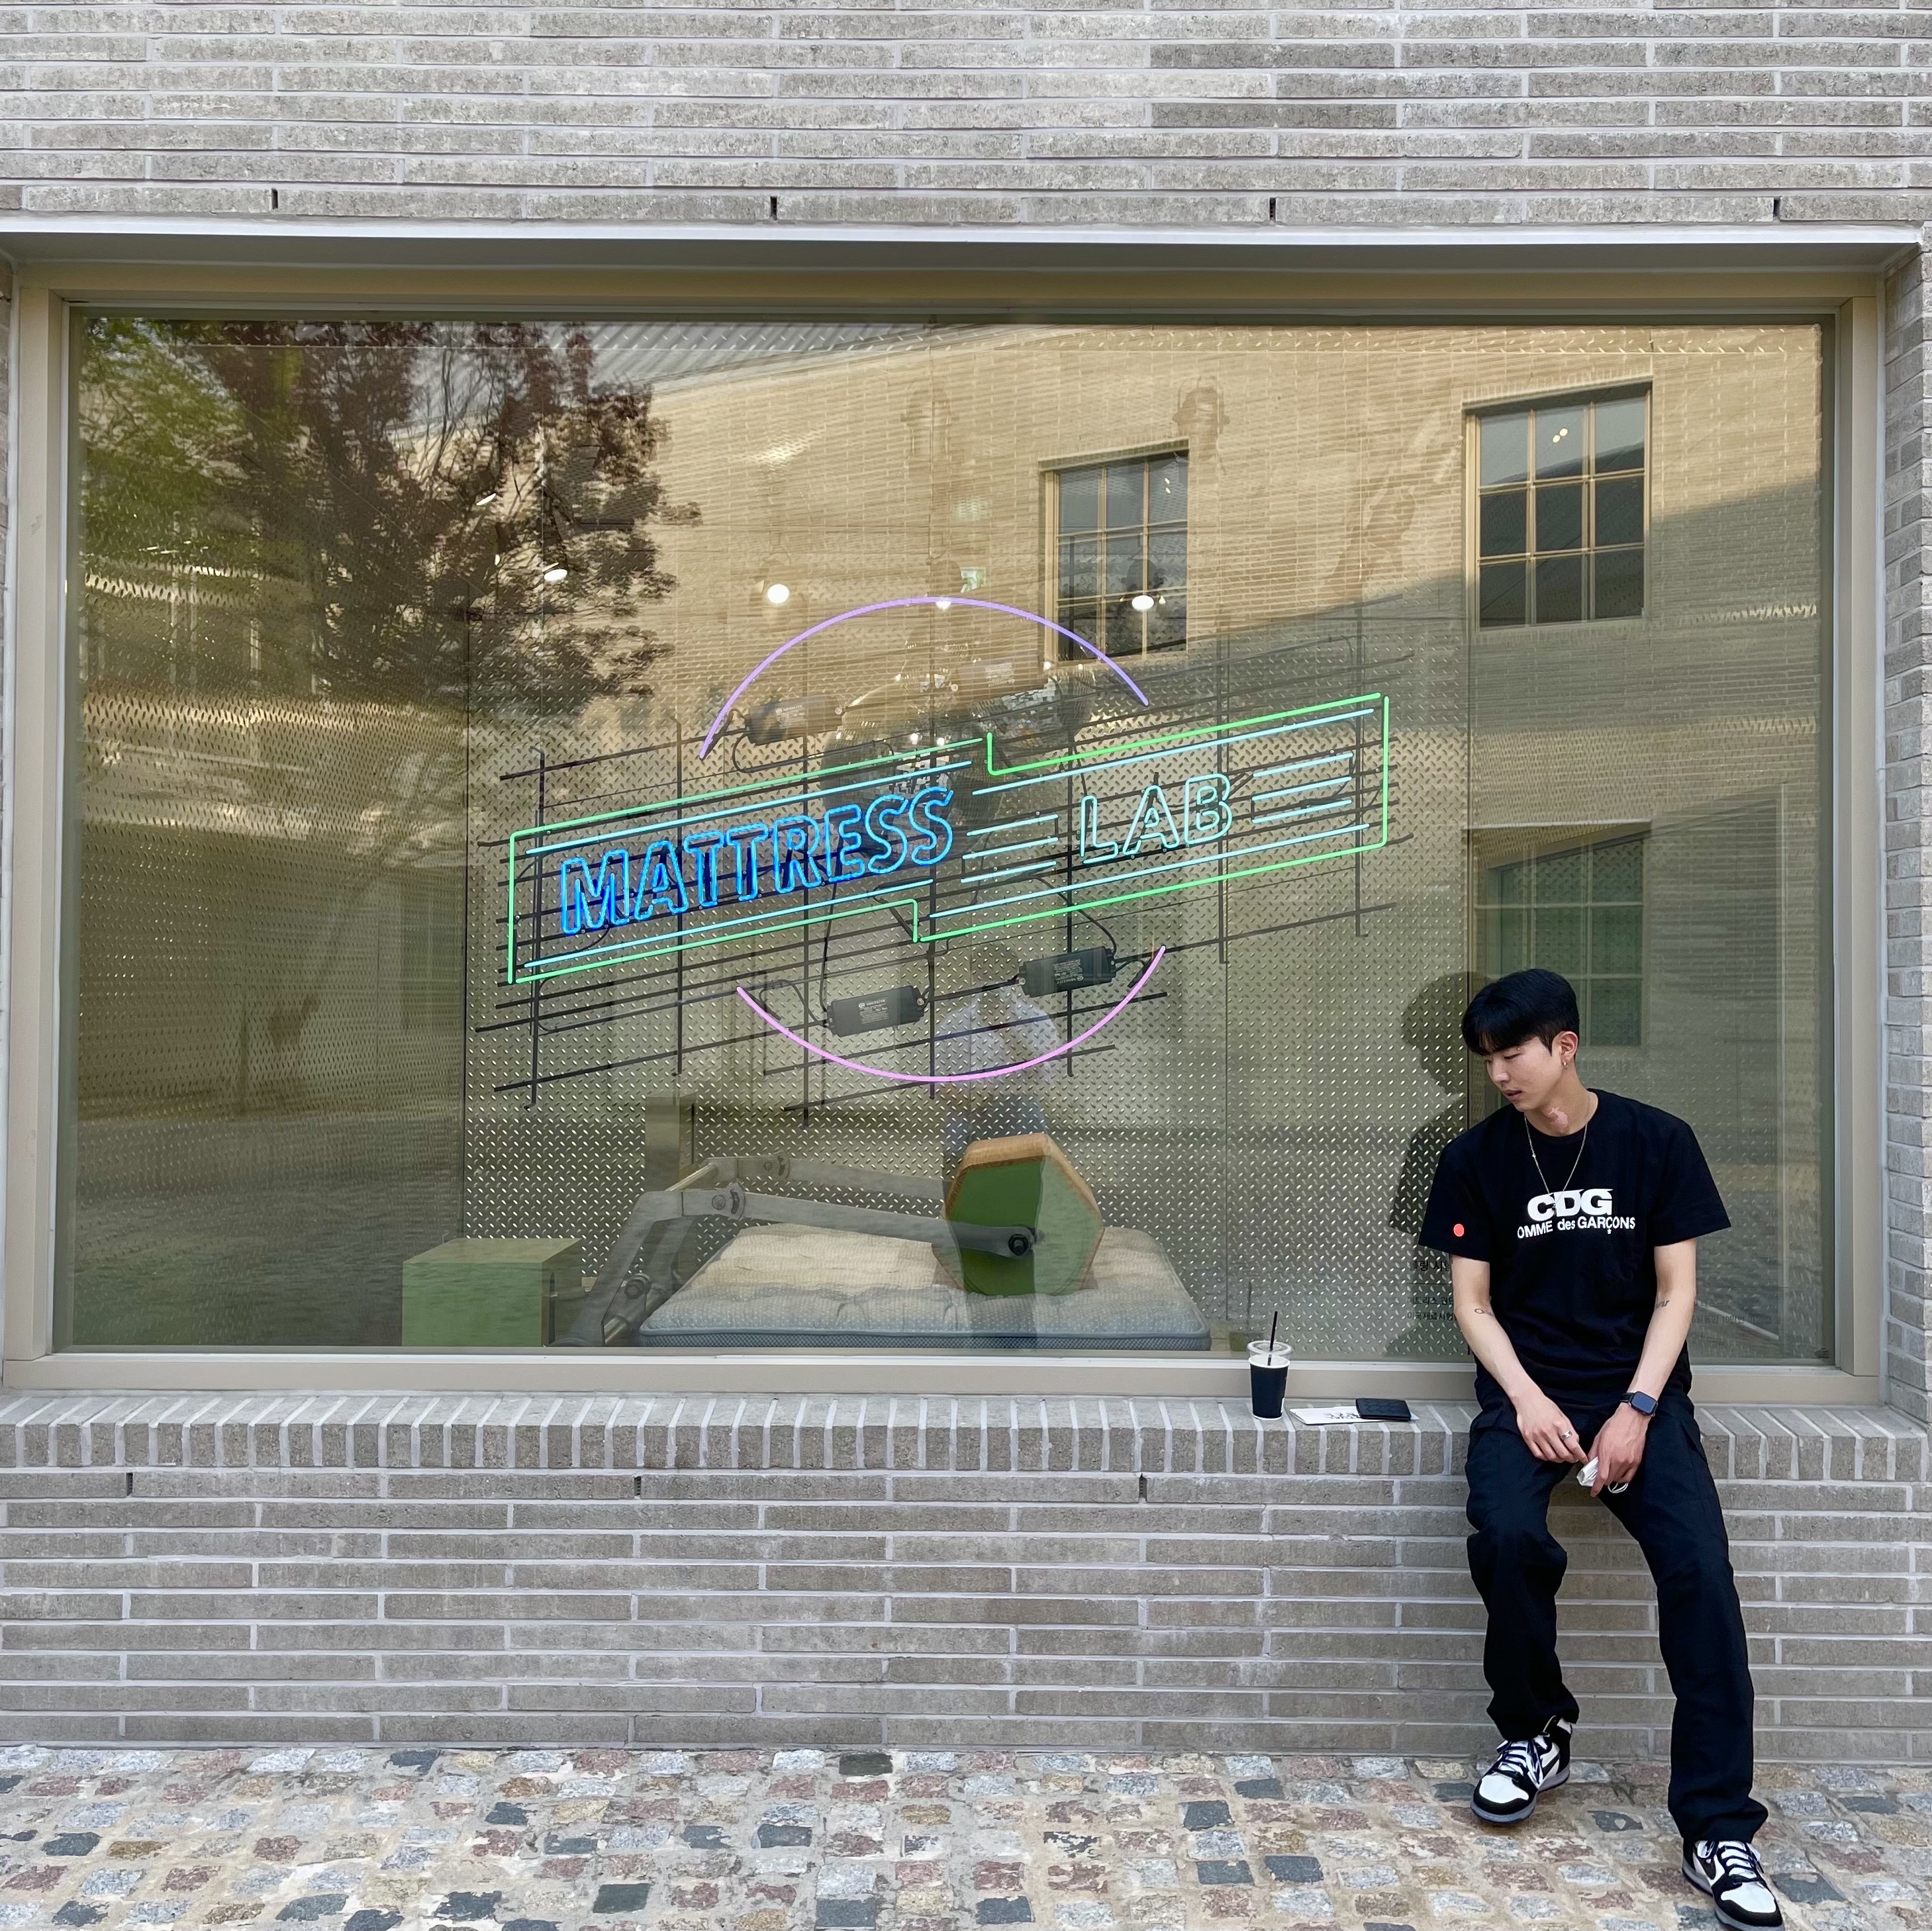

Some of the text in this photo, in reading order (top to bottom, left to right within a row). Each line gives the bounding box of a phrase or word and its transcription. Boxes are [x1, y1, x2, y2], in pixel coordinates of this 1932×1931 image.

[560, 773, 1233, 935] MATTRESS LAB
[1527, 1188, 1613, 1221] CDG
[1518, 1221, 1553, 1239] OMME
[1557, 1219, 1576, 1231] des
